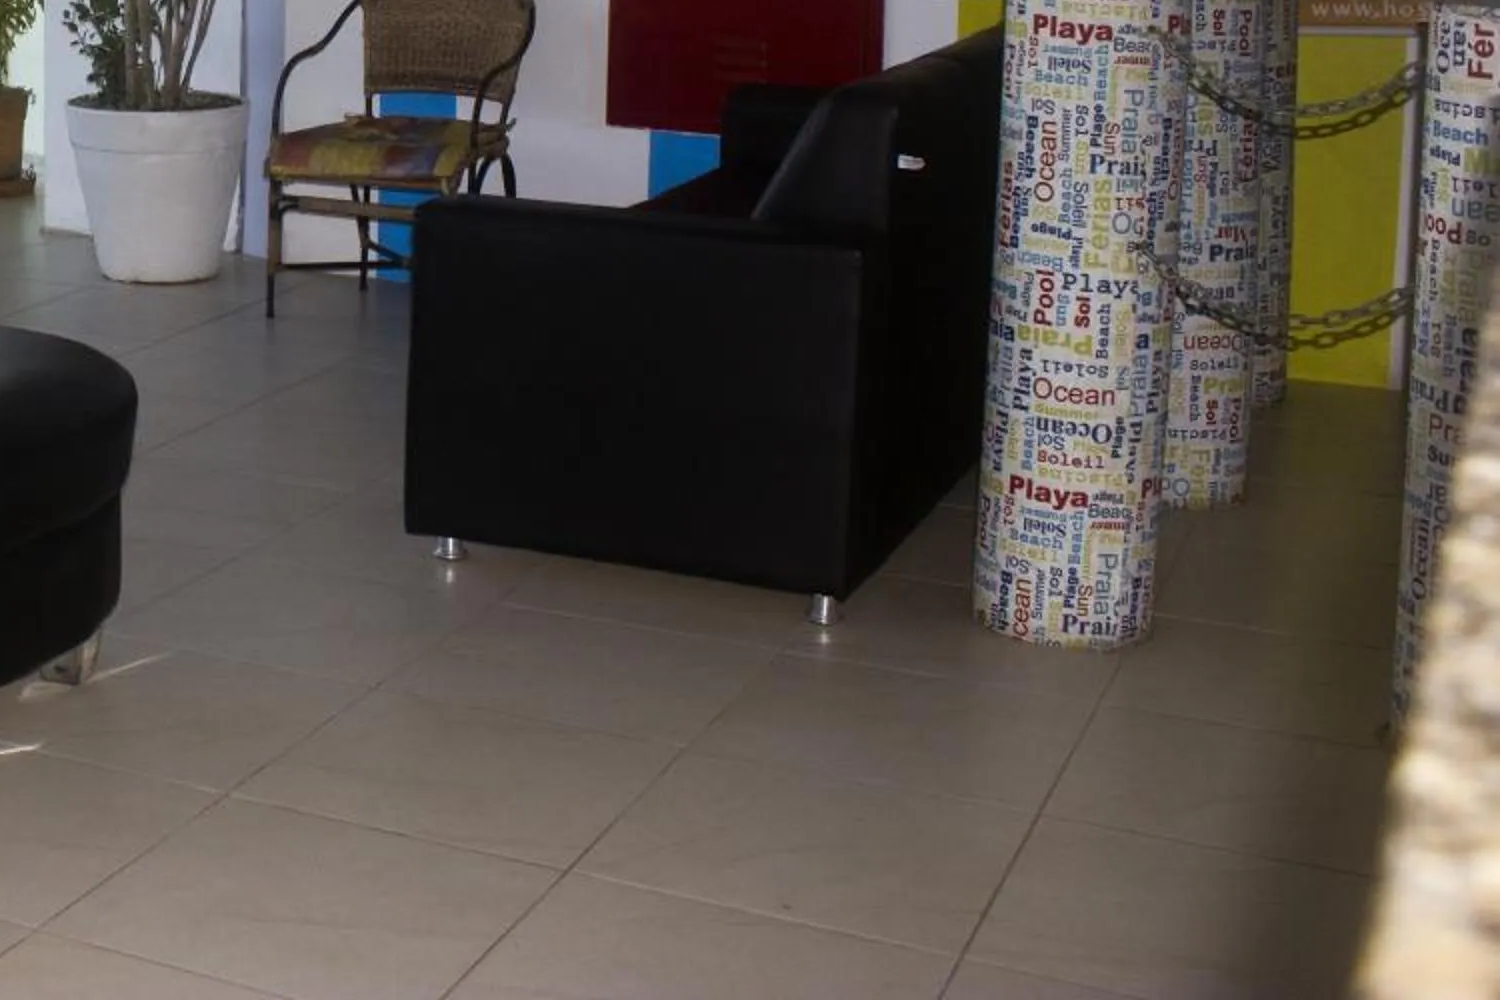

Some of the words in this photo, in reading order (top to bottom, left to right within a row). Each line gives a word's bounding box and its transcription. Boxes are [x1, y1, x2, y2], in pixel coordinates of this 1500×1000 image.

[1033, 13, 1113, 46] Playa
[1212, 8, 1226, 37] Sol
[1240, 9, 1253, 57] Pool
[1035, 70, 1089, 87] Beach
[1047, 56, 1092, 74] Soleil
[1031, 99, 1057, 116] Sol
[1076, 104, 1090, 137] Sol
[1120, 89, 1145, 154] Praia
[1058, 107, 1072, 162] Summer
[1090, 103, 1106, 148] Plage
[1103, 122, 1121, 156] Sun
[1432, 119, 1489, 147] Beach
[1026, 115, 1039, 179] Beach
[1034, 120, 1059, 202] Ocean
[1090, 153, 1145, 175] Prai
[1030, 222, 1072, 240] Plage
[1426, 213, 1462, 245] Poo
[1429, 240, 1442, 302] Beach
[1034, 268, 1056, 327] Pool
[1074, 291, 1092, 329] Sol
[1016, 325, 1093, 358] Praia
[1097, 303, 1112, 361] Beach
[1184, 334, 1245, 352] Ocean
[1012, 346, 1034, 412] Playa
[1041, 358, 1109, 379] Soleil
[1190, 354, 1241, 372] Soleil
[1032, 375, 1117, 407] Ocean
[1206, 399, 1218, 426] Sol
[1229, 397, 1242, 444] Pool
[1036, 417, 1113, 445] Ocean
[1038, 434, 1067, 451] Sol
[1112, 416, 1127, 459] Plage
[1166, 429, 1228, 442] Piscin
[1037, 449, 1105, 469] Soleil
[1009, 474, 1089, 511] Playa
[1009, 527, 1064, 550] Beach
[1023, 518, 1067, 538] Soleil
[1007, 555, 1031, 575] Sol
[1032, 568, 1047, 621] Summer
[1049, 566, 1062, 598] Sol
[1063, 566, 1080, 609] Plage
[1094, 551, 1118, 616] Praia
[998, 569, 1013, 632] Beach
[1013, 577, 1033, 640] cean
[1077, 583, 1092, 617] Sun
[1060, 611, 1116, 637] Prai
